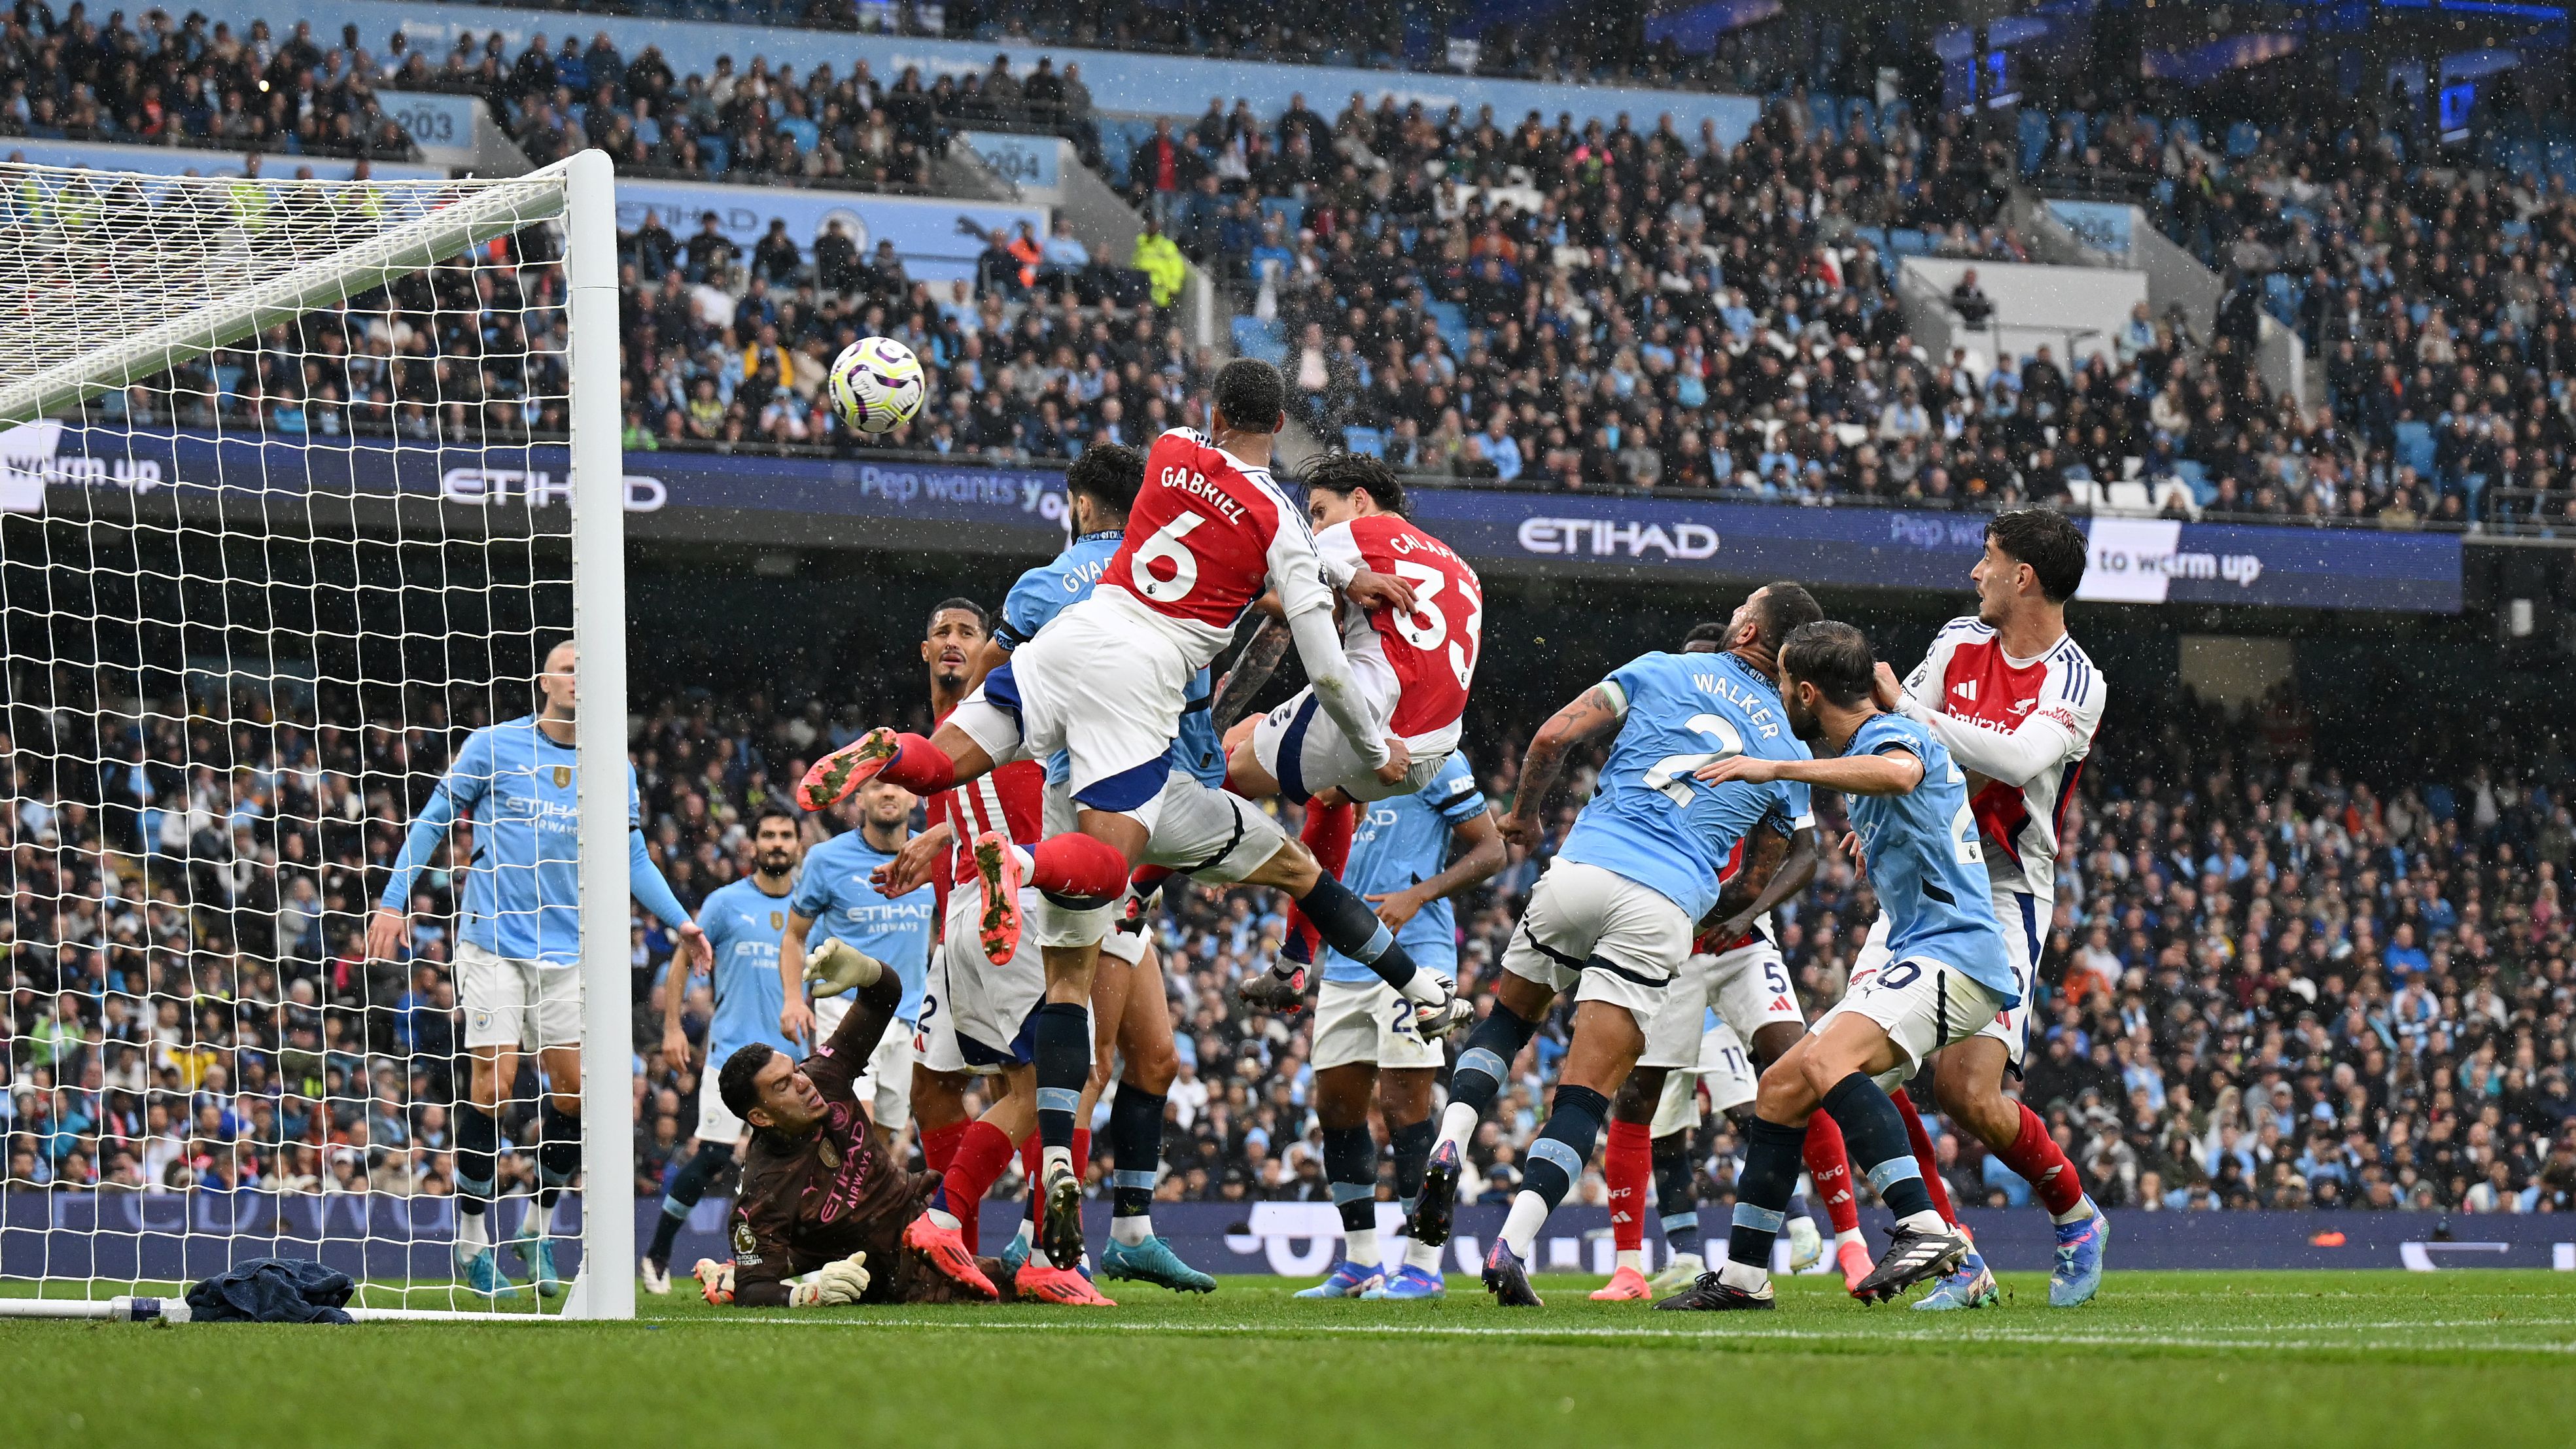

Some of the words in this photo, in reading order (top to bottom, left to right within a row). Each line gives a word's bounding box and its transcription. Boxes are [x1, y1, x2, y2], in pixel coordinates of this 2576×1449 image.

[395, 109, 453, 142] 203
[113, 457, 162, 495] up
[442, 467, 668, 513] ETIHD
[860, 466, 919, 506] Pep
[1160, 466, 1246, 526] GABRIEL
[1130, 510, 1207, 602] 6
[1517, 517, 1720, 559] ETIHAD
[2098, 547, 2127, 572] to
[2221, 555, 2263, 587] up
[1392, 559, 1484, 691] 33
[1692, 672, 1780, 741] WALKER
[1642, 712, 1744, 810] 2
[846, 904, 934, 922] ETIHAD
[867, 921, 919, 934] AIRWAYS
[1763, 962, 1787, 994] 5
[917, 994, 937, 1034] 2
[1721, 1046, 1748, 1074] 11
[820, 1120, 865, 1223] ETIHAD
[846, 1149, 872, 1210] AIRWAYS
[1817, 1164, 1844, 1181] AFC
